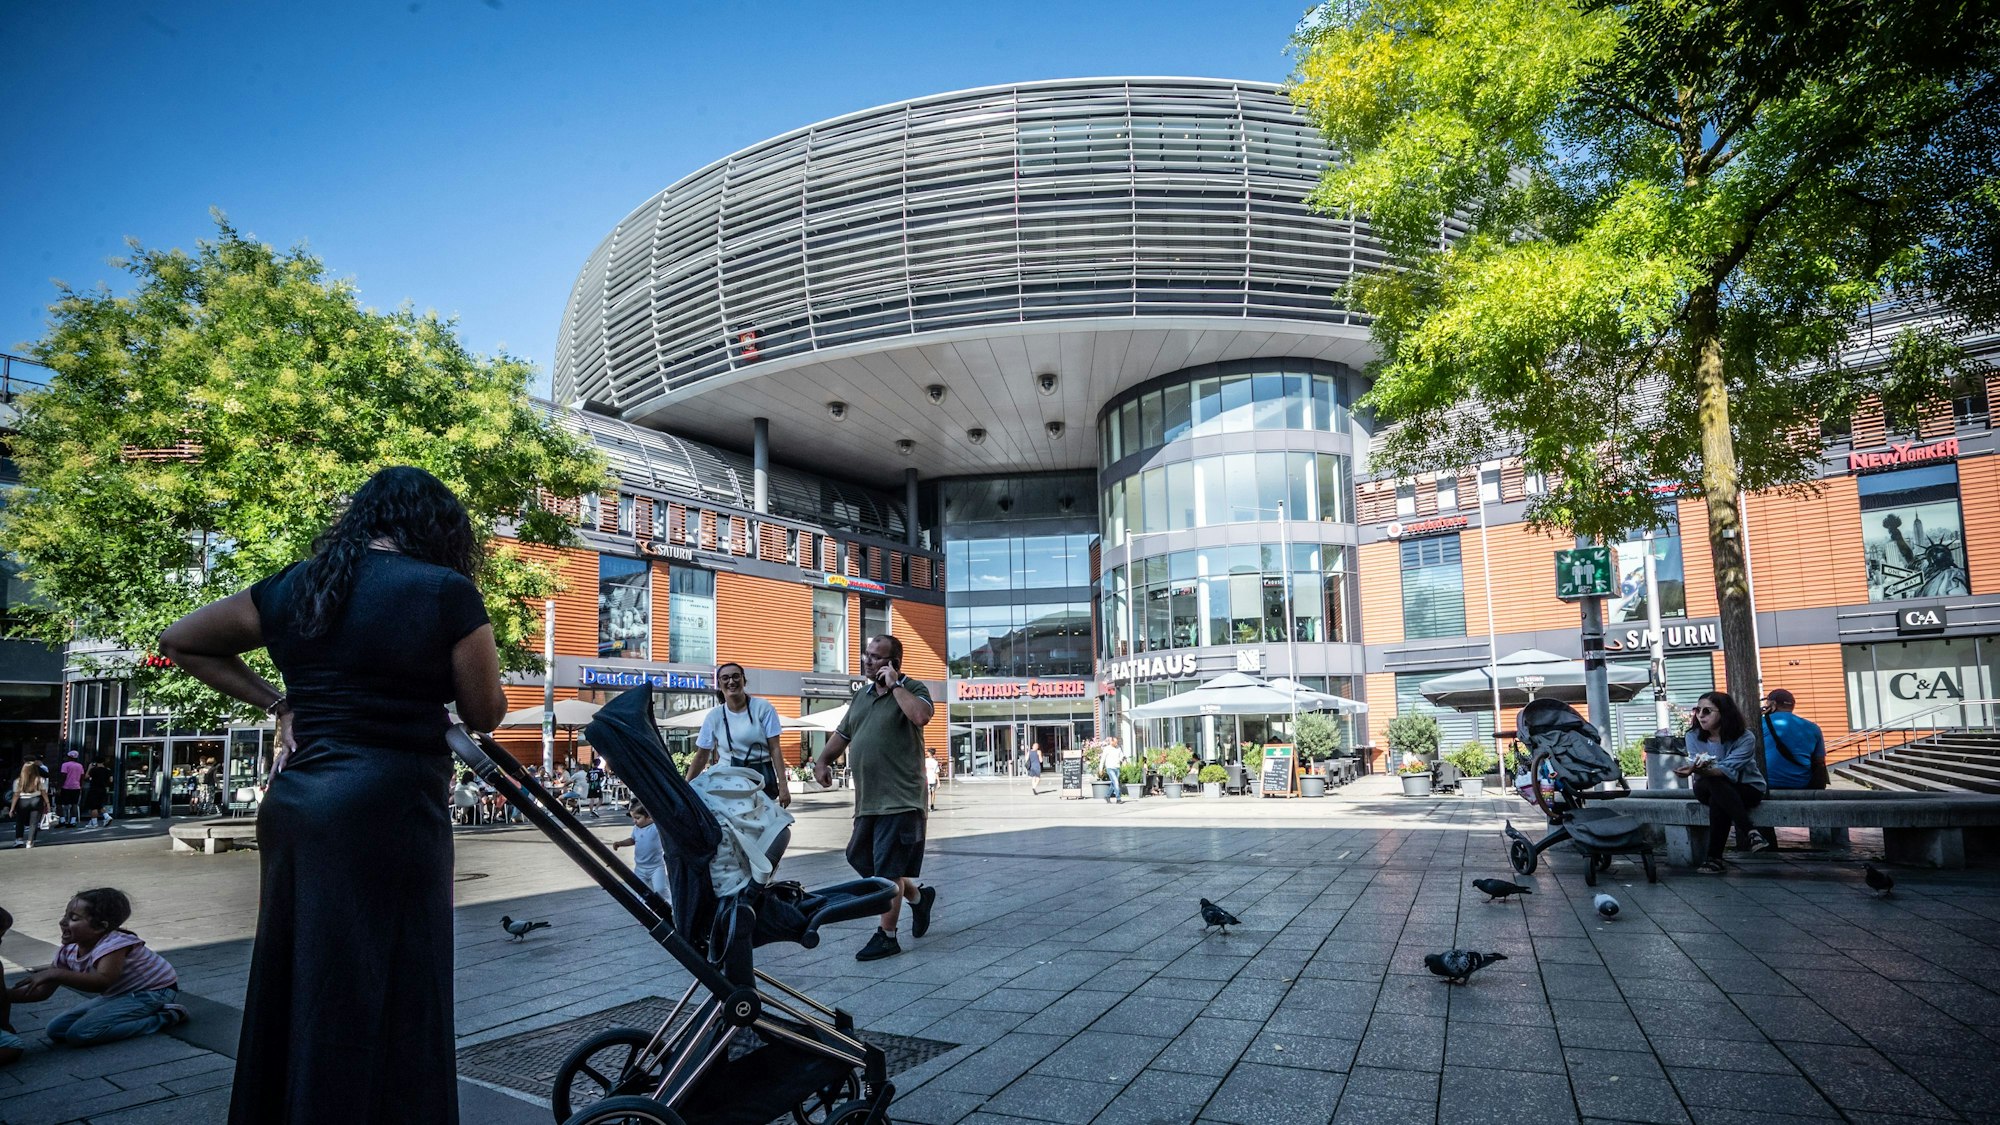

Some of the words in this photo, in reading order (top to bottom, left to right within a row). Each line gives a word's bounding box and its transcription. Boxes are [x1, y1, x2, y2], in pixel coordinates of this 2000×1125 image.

[1407, 516, 1468, 533] vodafone
[657, 544, 693, 560] SATURN
[1905, 610, 1941, 626] C&A
[1626, 624, 1716, 650] SAURN
[1111, 653, 1197, 681] RATHAUS
[583, 667, 664, 688] Deutsche
[667, 672, 706, 689] Bank
[1890, 671, 1964, 700] C&A
[957, 681, 1021, 699] RATHAUS
[1028, 679, 1086, 698] GALERIE
